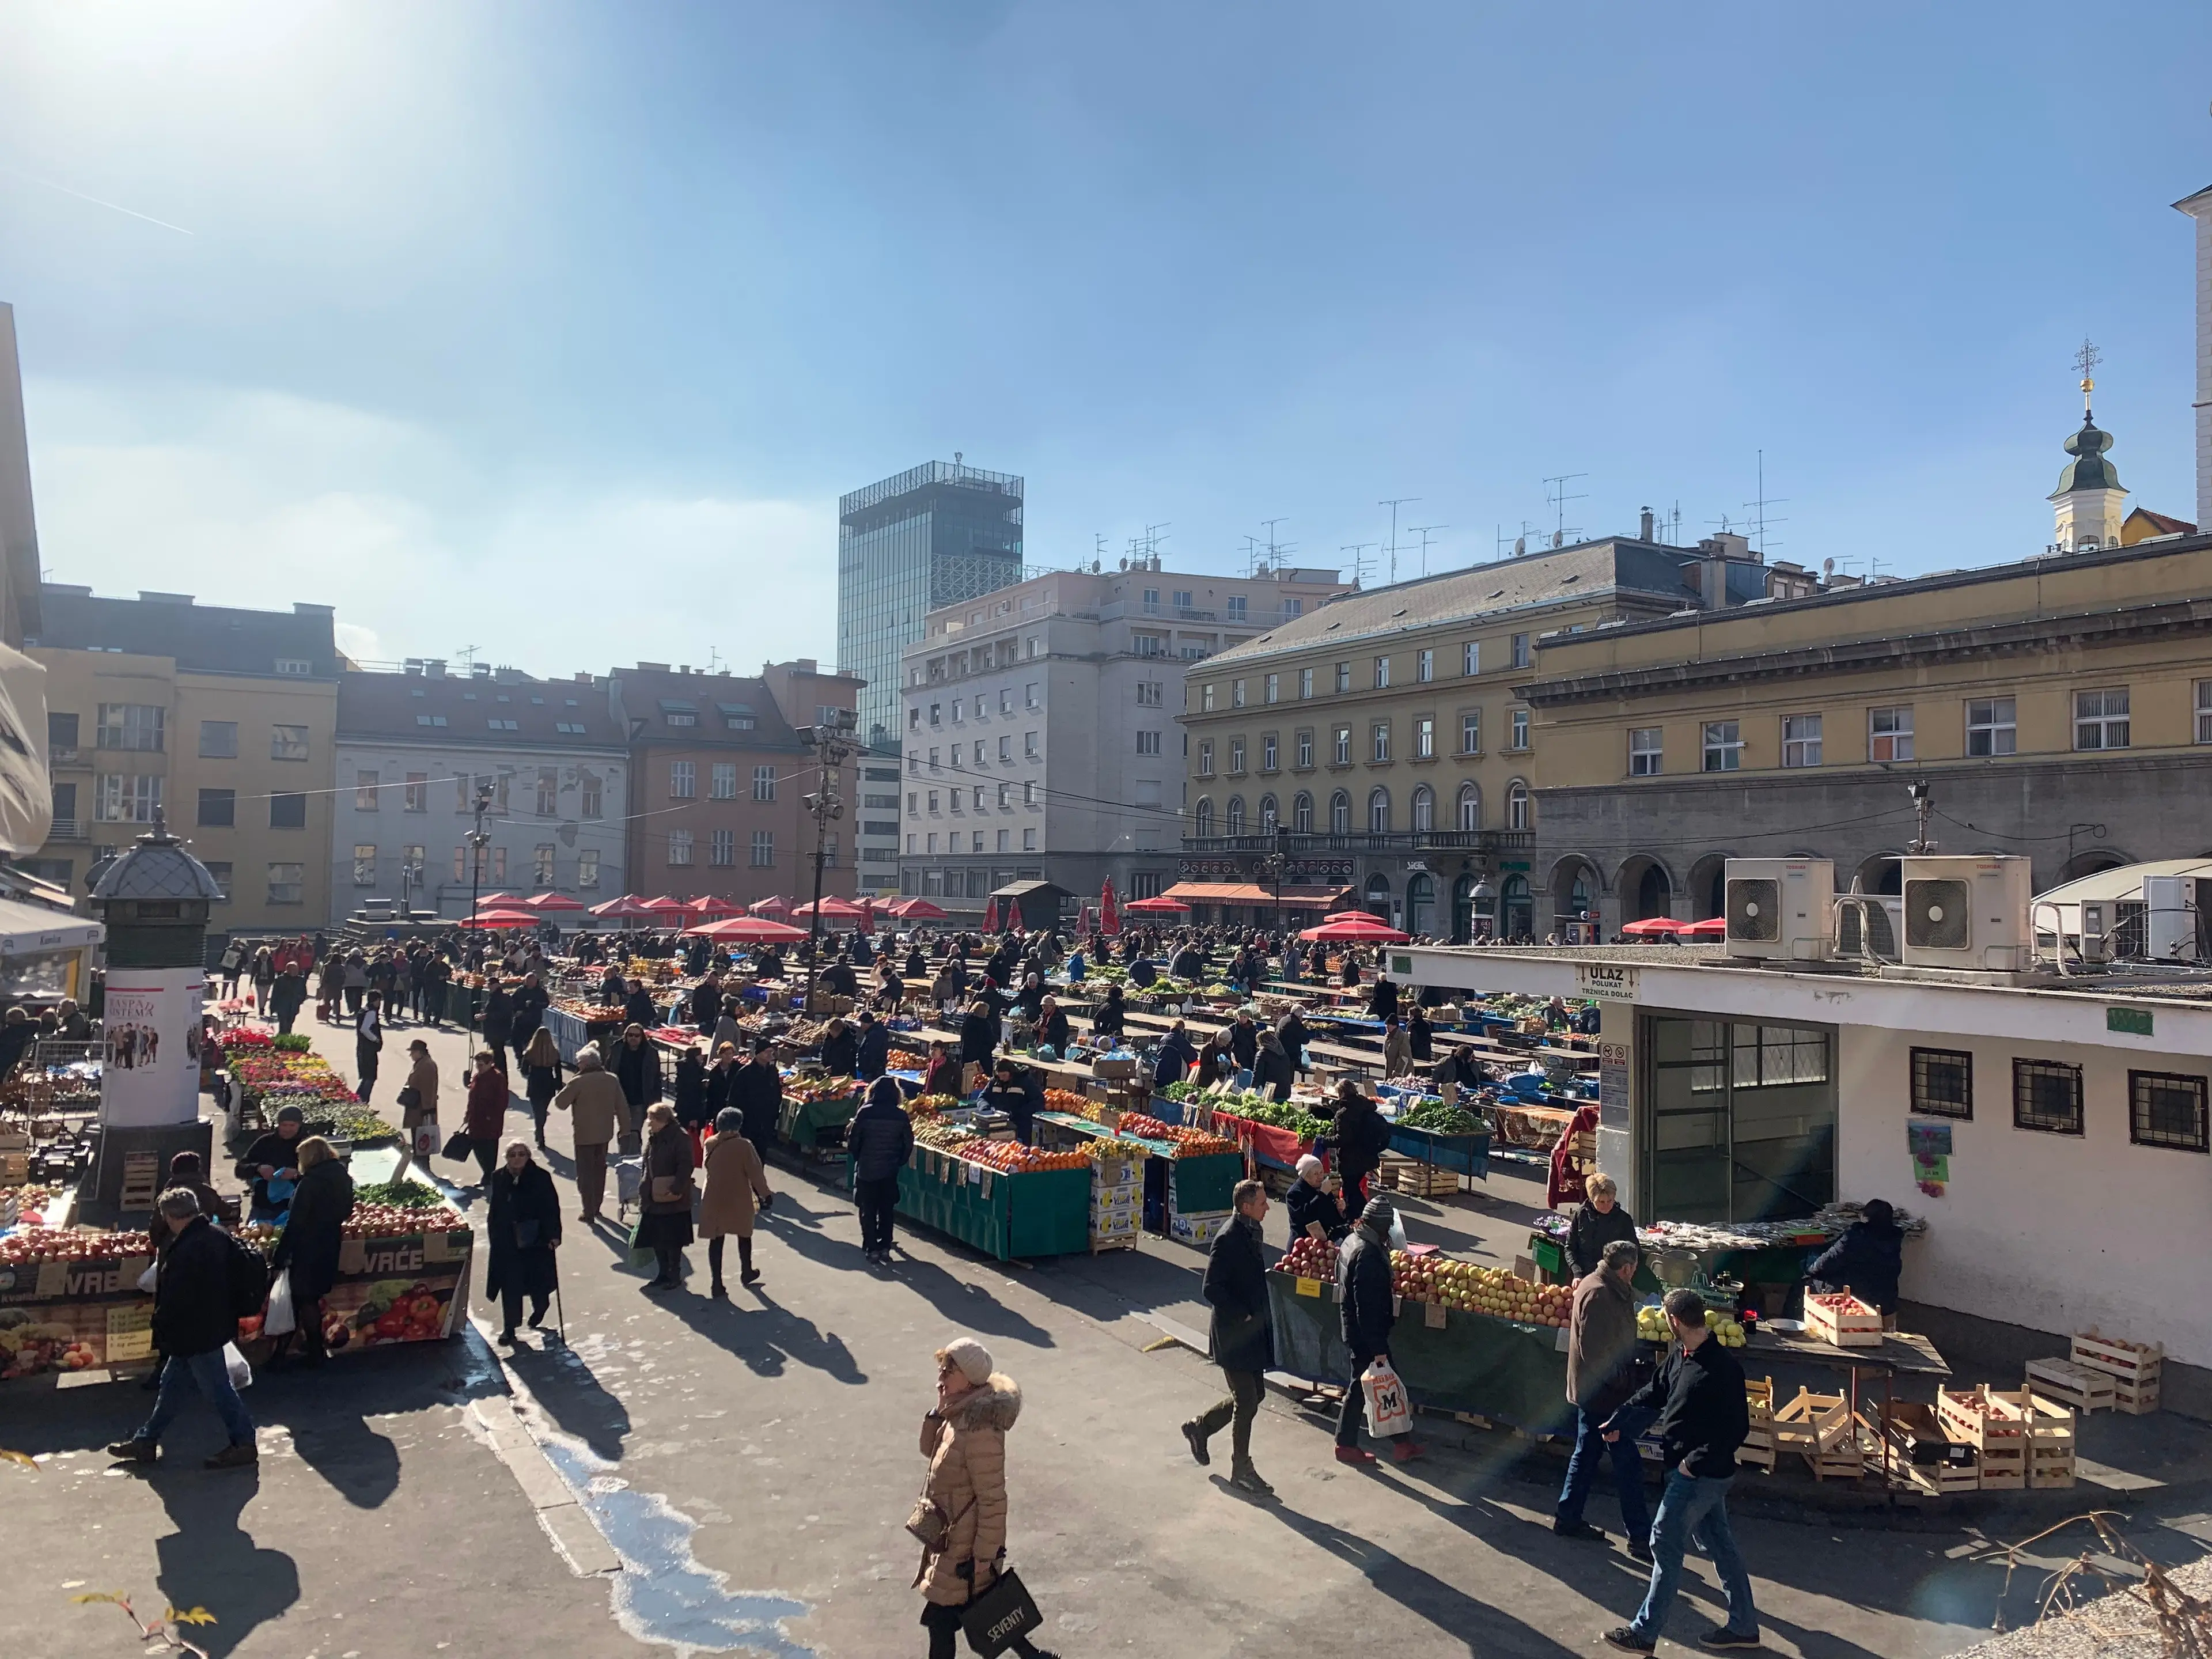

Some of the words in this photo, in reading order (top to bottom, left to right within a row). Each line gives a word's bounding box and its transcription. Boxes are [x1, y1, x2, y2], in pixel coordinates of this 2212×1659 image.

[1590, 967, 1623, 981] ULAZ
[1582, 987, 1609, 997] TRŽNICA
[1592, 980, 1622, 988] POLUKAT
[363, 1244, 423, 1273] VRĆE
[1382, 1392, 1397, 1411] M
[987, 1607, 1025, 1642] SEVENTY
